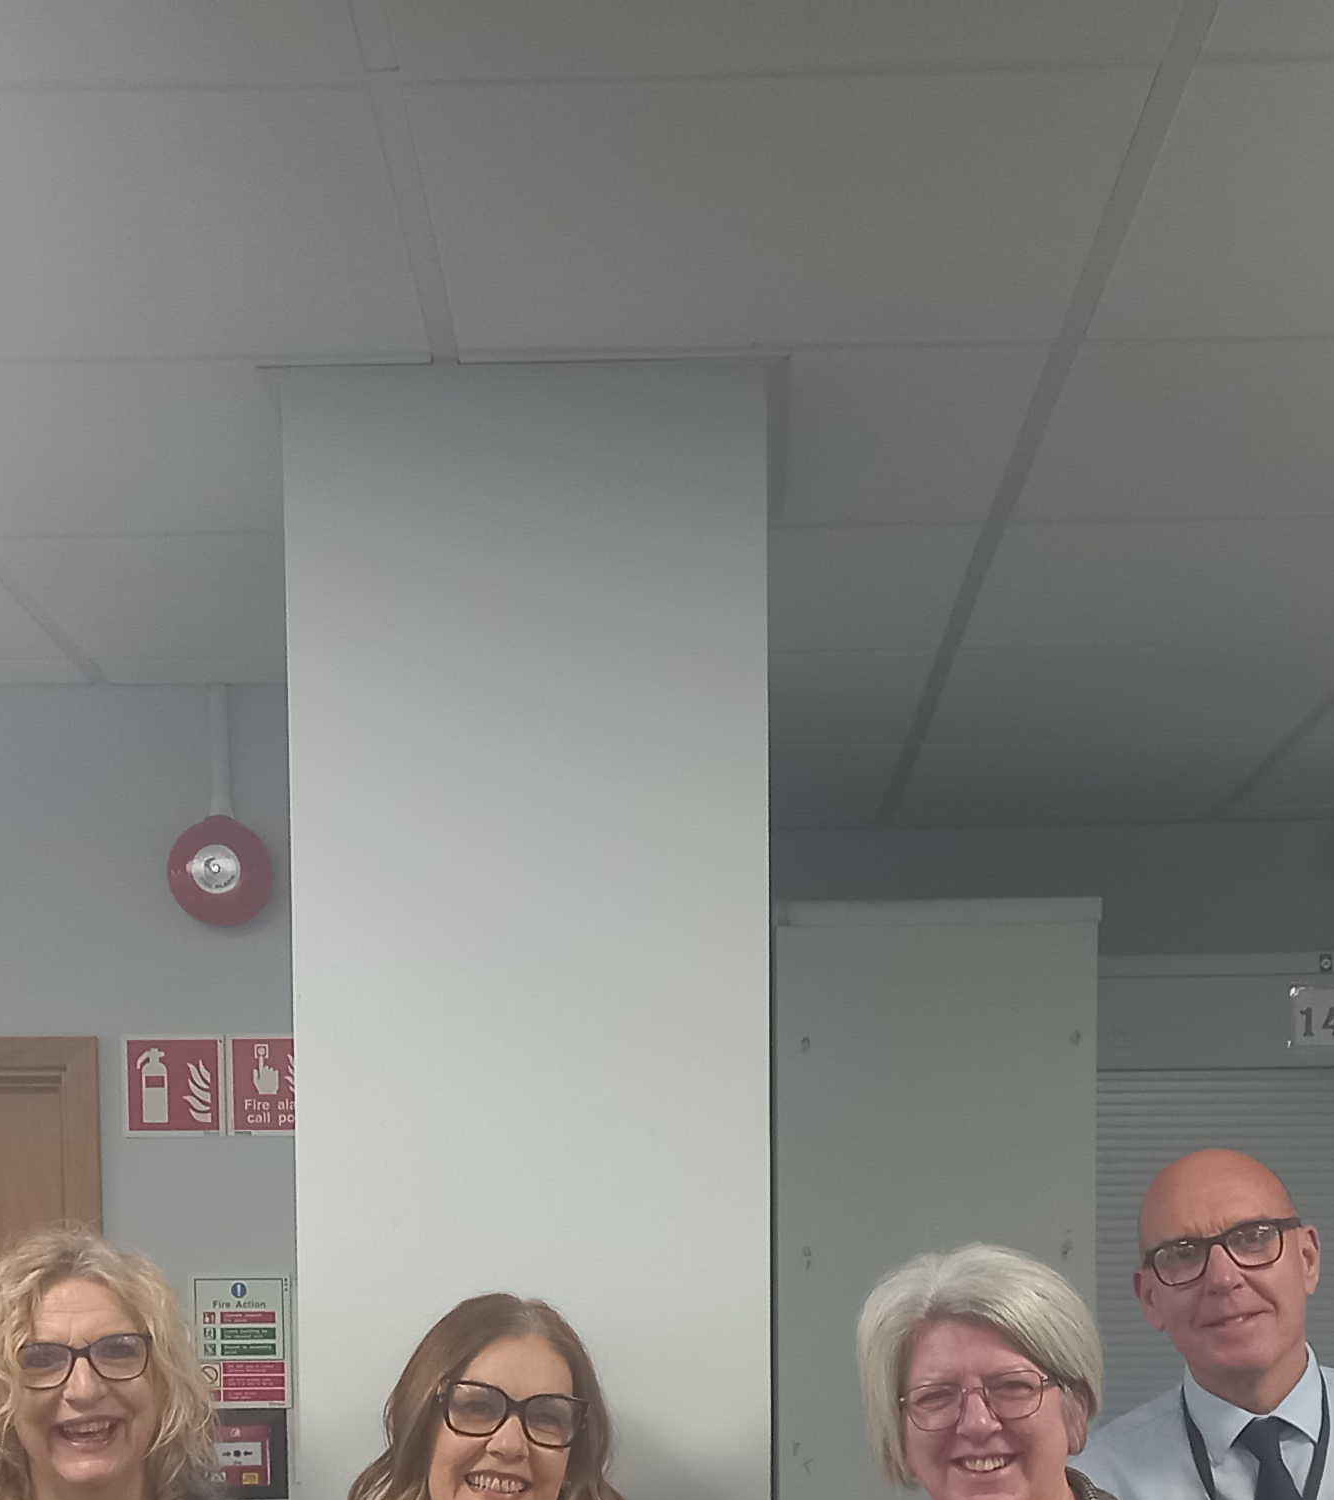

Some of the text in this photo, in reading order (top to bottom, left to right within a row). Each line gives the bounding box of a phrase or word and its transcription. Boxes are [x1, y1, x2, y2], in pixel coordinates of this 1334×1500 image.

[244, 1099, 295, 1111] Fire ala
[247, 1112, 295, 1126] call po
[212, 1300, 267, 1309] Fire Action
